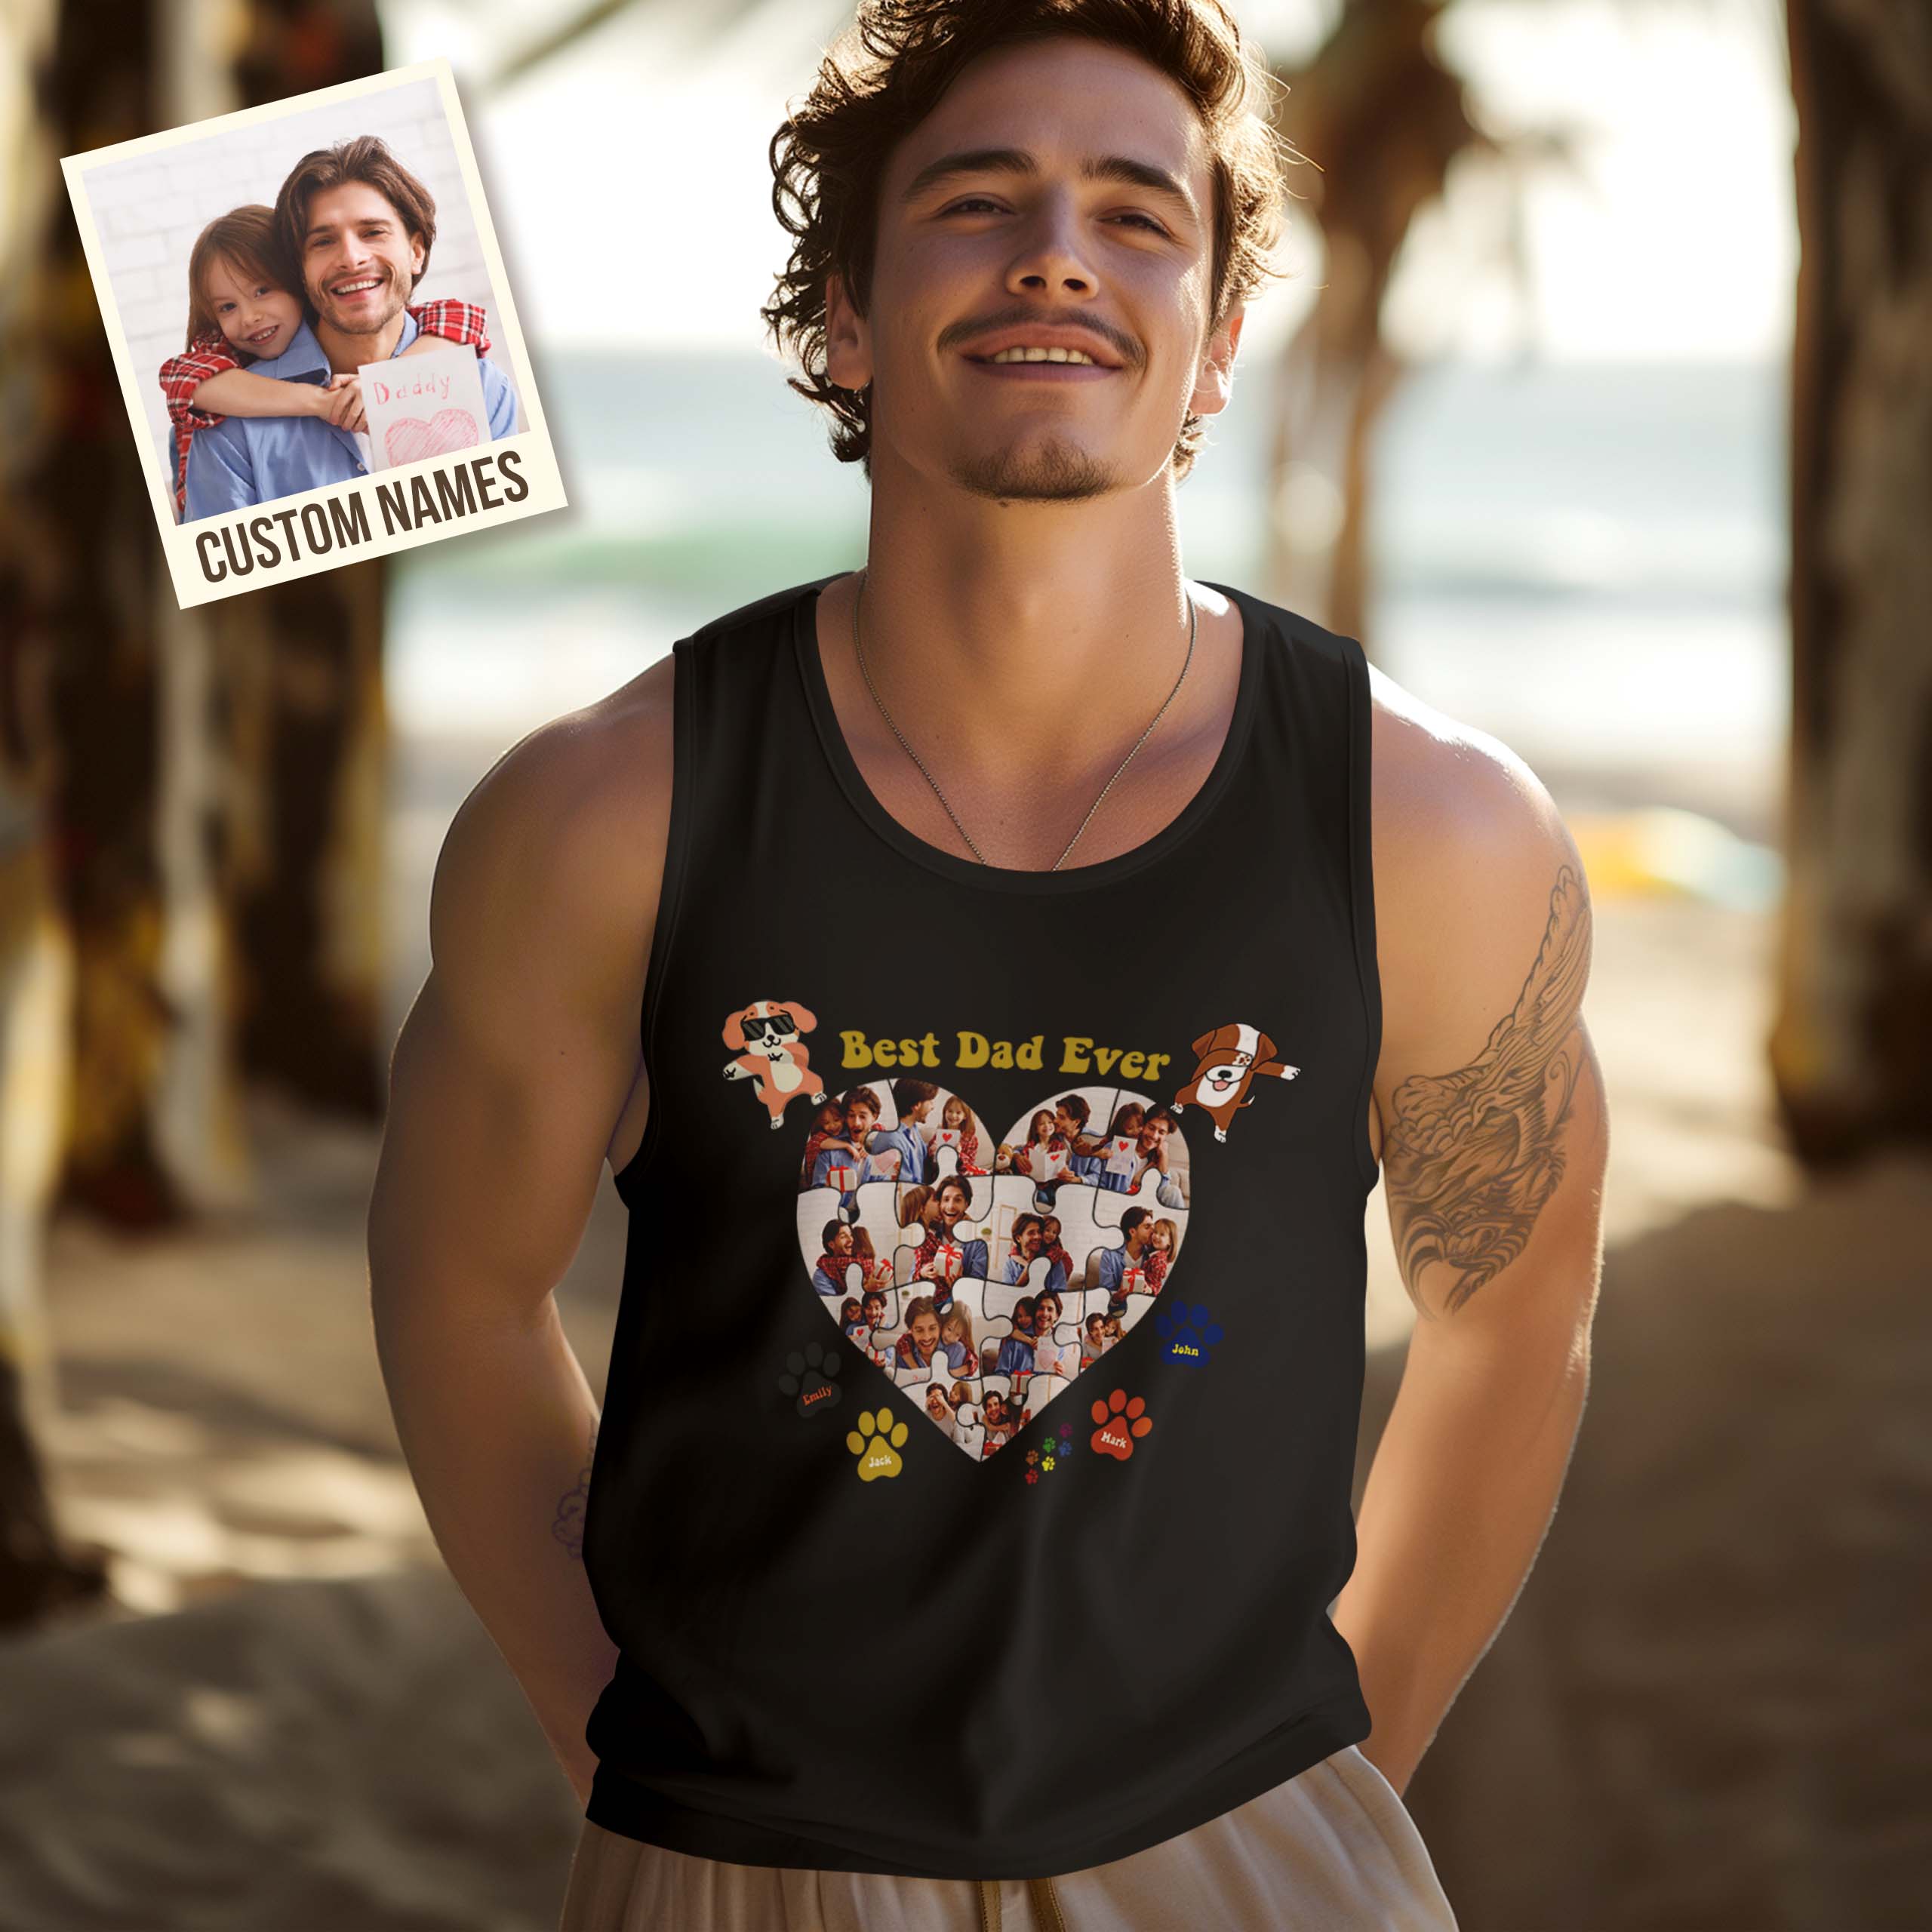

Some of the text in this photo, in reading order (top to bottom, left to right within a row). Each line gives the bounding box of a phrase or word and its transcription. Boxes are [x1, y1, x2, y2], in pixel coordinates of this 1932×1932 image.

[374, 373, 450, 405] Daddy
[839, 1030, 1171, 1081] Best Dad Ever
[1172, 1343, 1199, 1357] John
[1100, 1431, 1127, 1449] Mark
[869, 1455, 892, 1468] Jack
